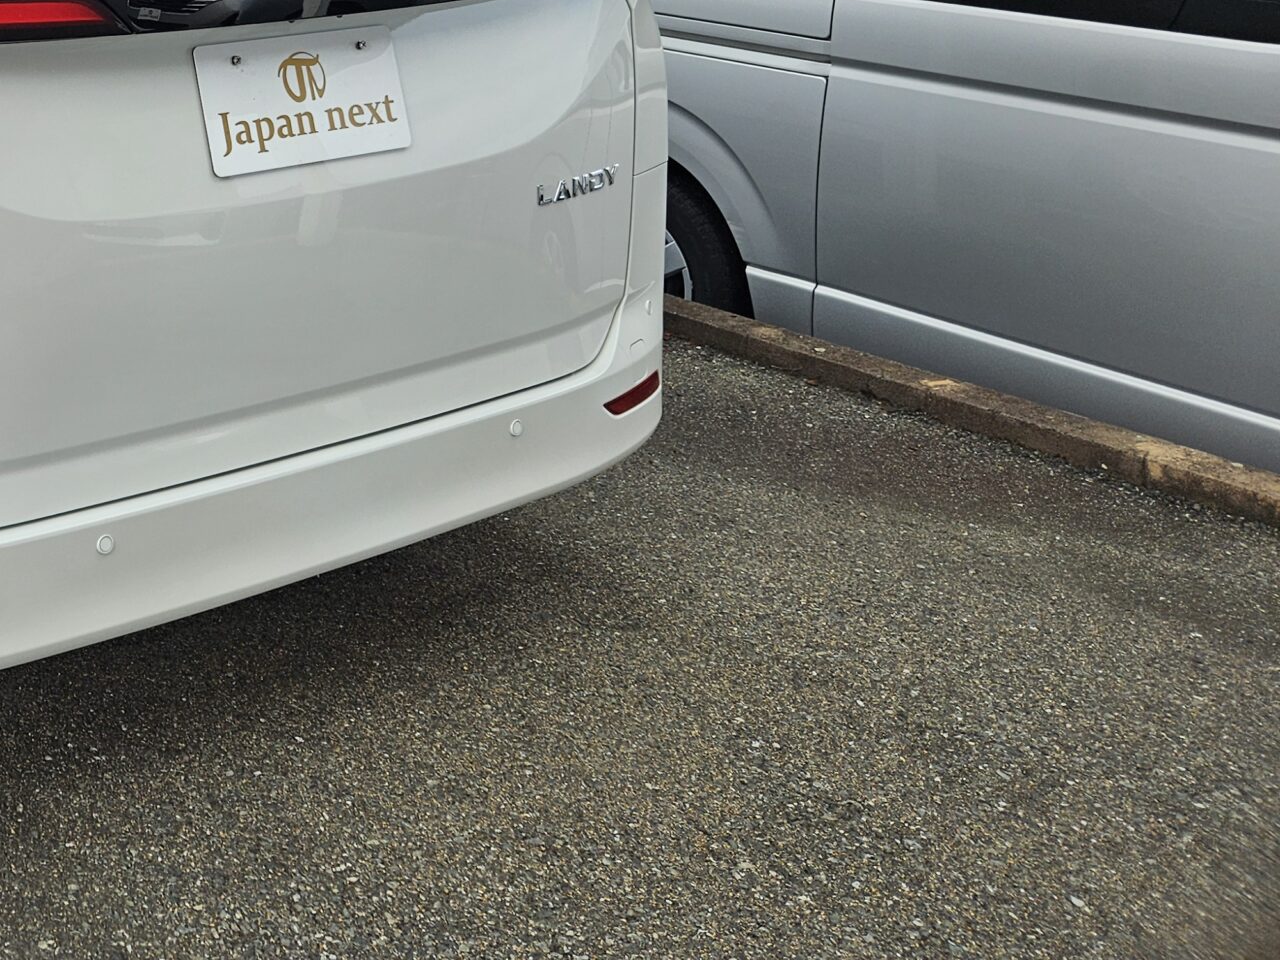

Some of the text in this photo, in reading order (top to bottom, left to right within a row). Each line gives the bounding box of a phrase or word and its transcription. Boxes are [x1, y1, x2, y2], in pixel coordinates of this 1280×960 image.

[218, 95, 398, 158] Japan next
[536, 163, 620, 206] LANDY
